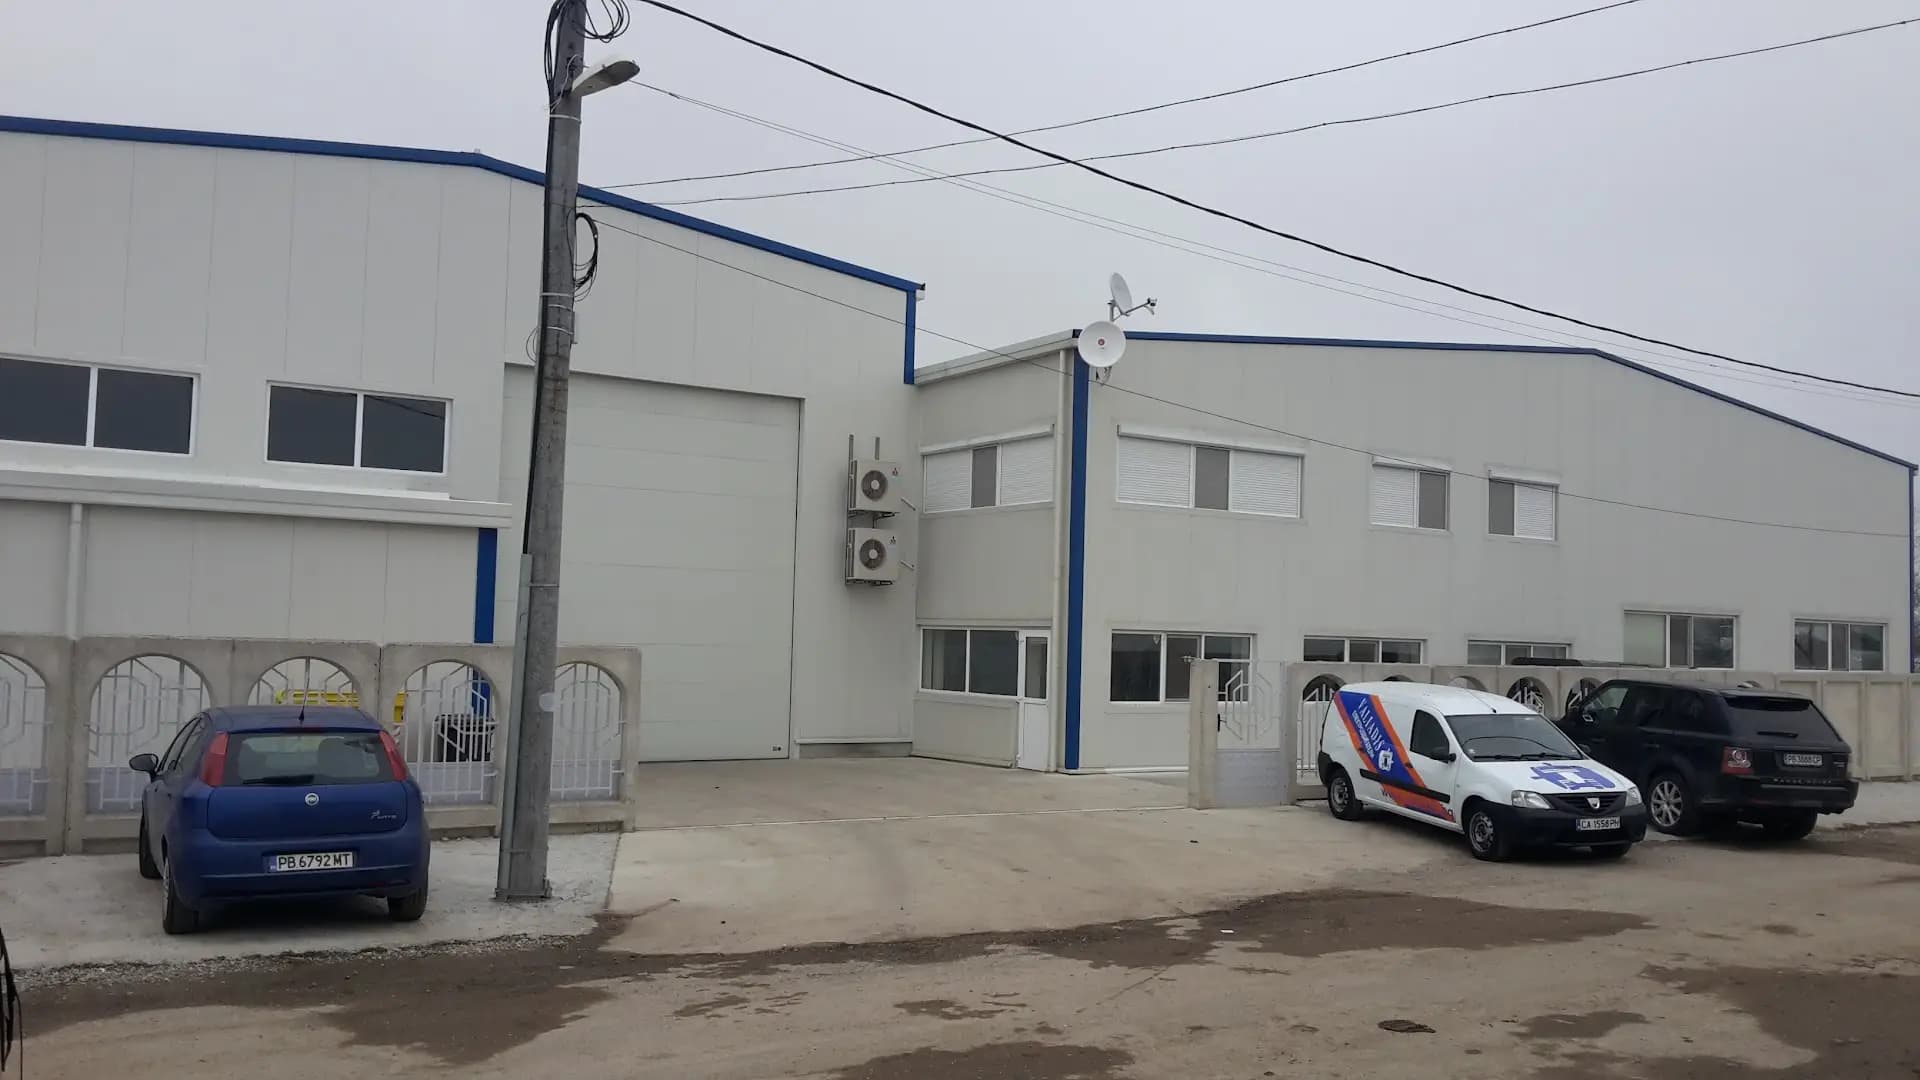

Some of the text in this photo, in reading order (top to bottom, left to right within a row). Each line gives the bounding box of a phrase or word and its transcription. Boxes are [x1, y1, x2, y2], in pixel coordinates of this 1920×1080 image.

[1358, 698, 1385, 751] VALIADIS
[278, 853, 351, 869] PB 6792 MT
